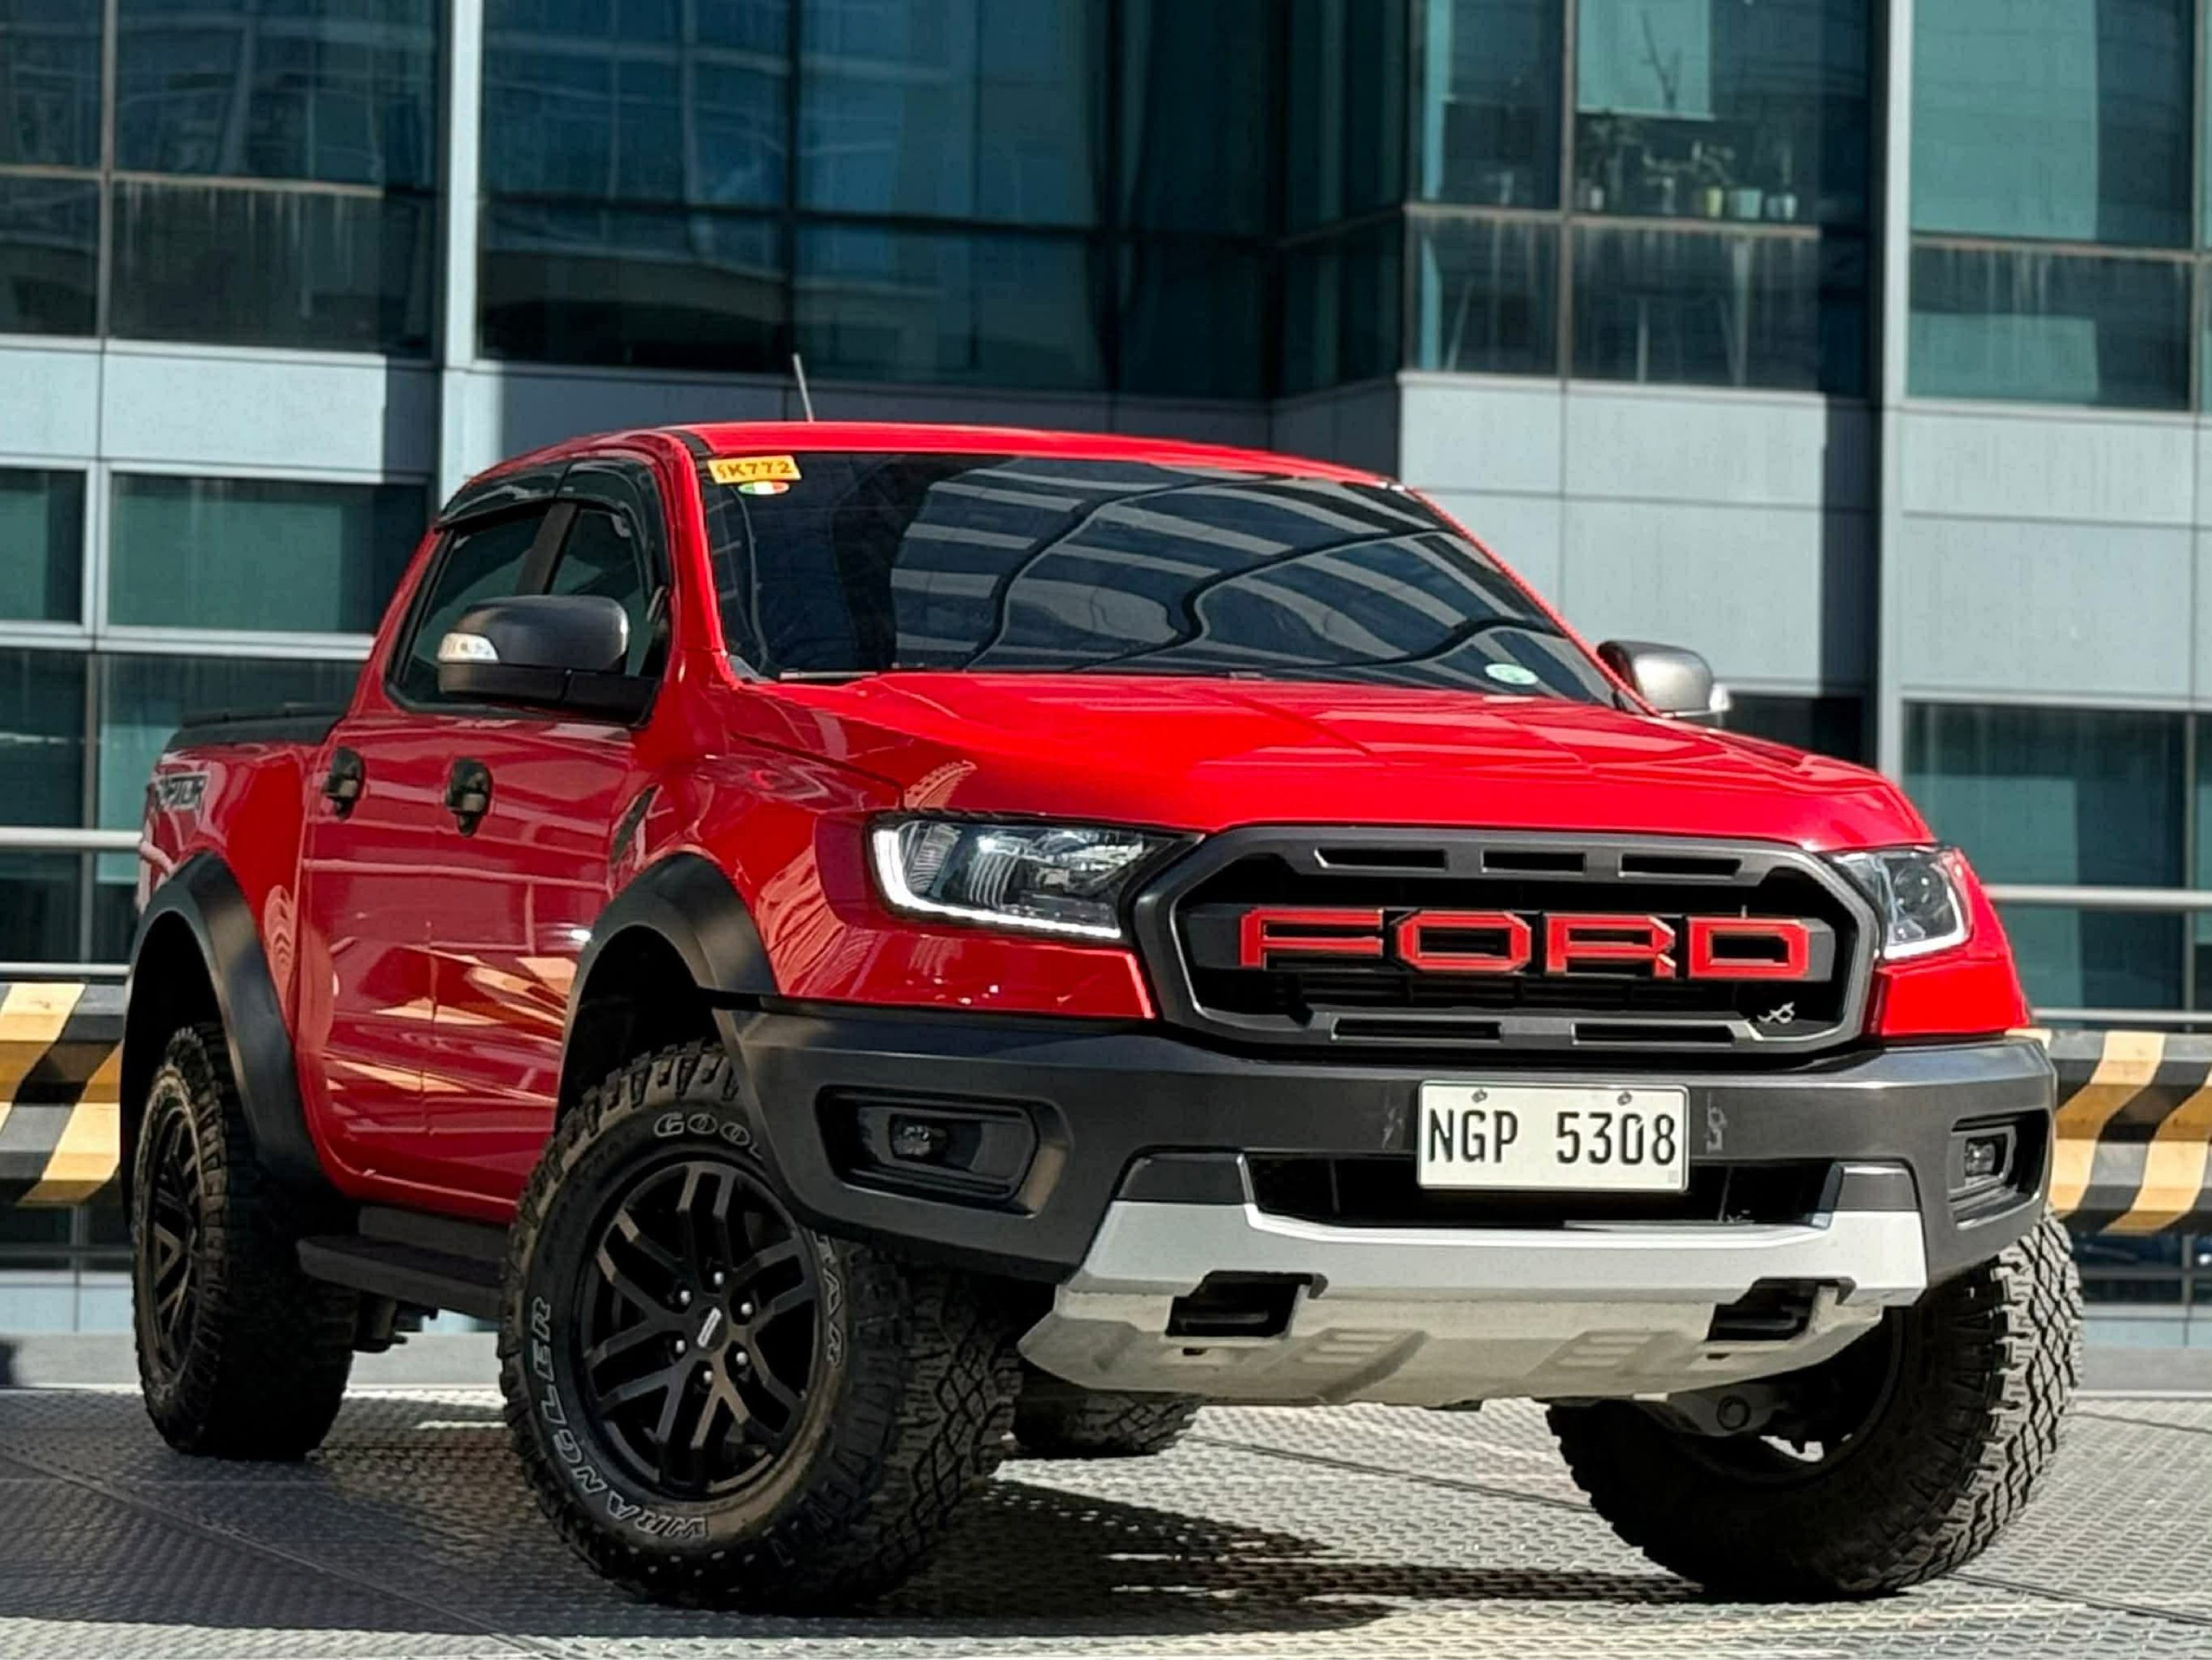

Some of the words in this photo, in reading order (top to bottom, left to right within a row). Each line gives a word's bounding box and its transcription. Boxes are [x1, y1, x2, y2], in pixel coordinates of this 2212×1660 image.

[1238, 907, 1811, 981] FORD
[1428, 1108, 1518, 1163] NGP
[1555, 1111, 1677, 1166] 5308
[531, 1296, 708, 1538] WRANGLER
